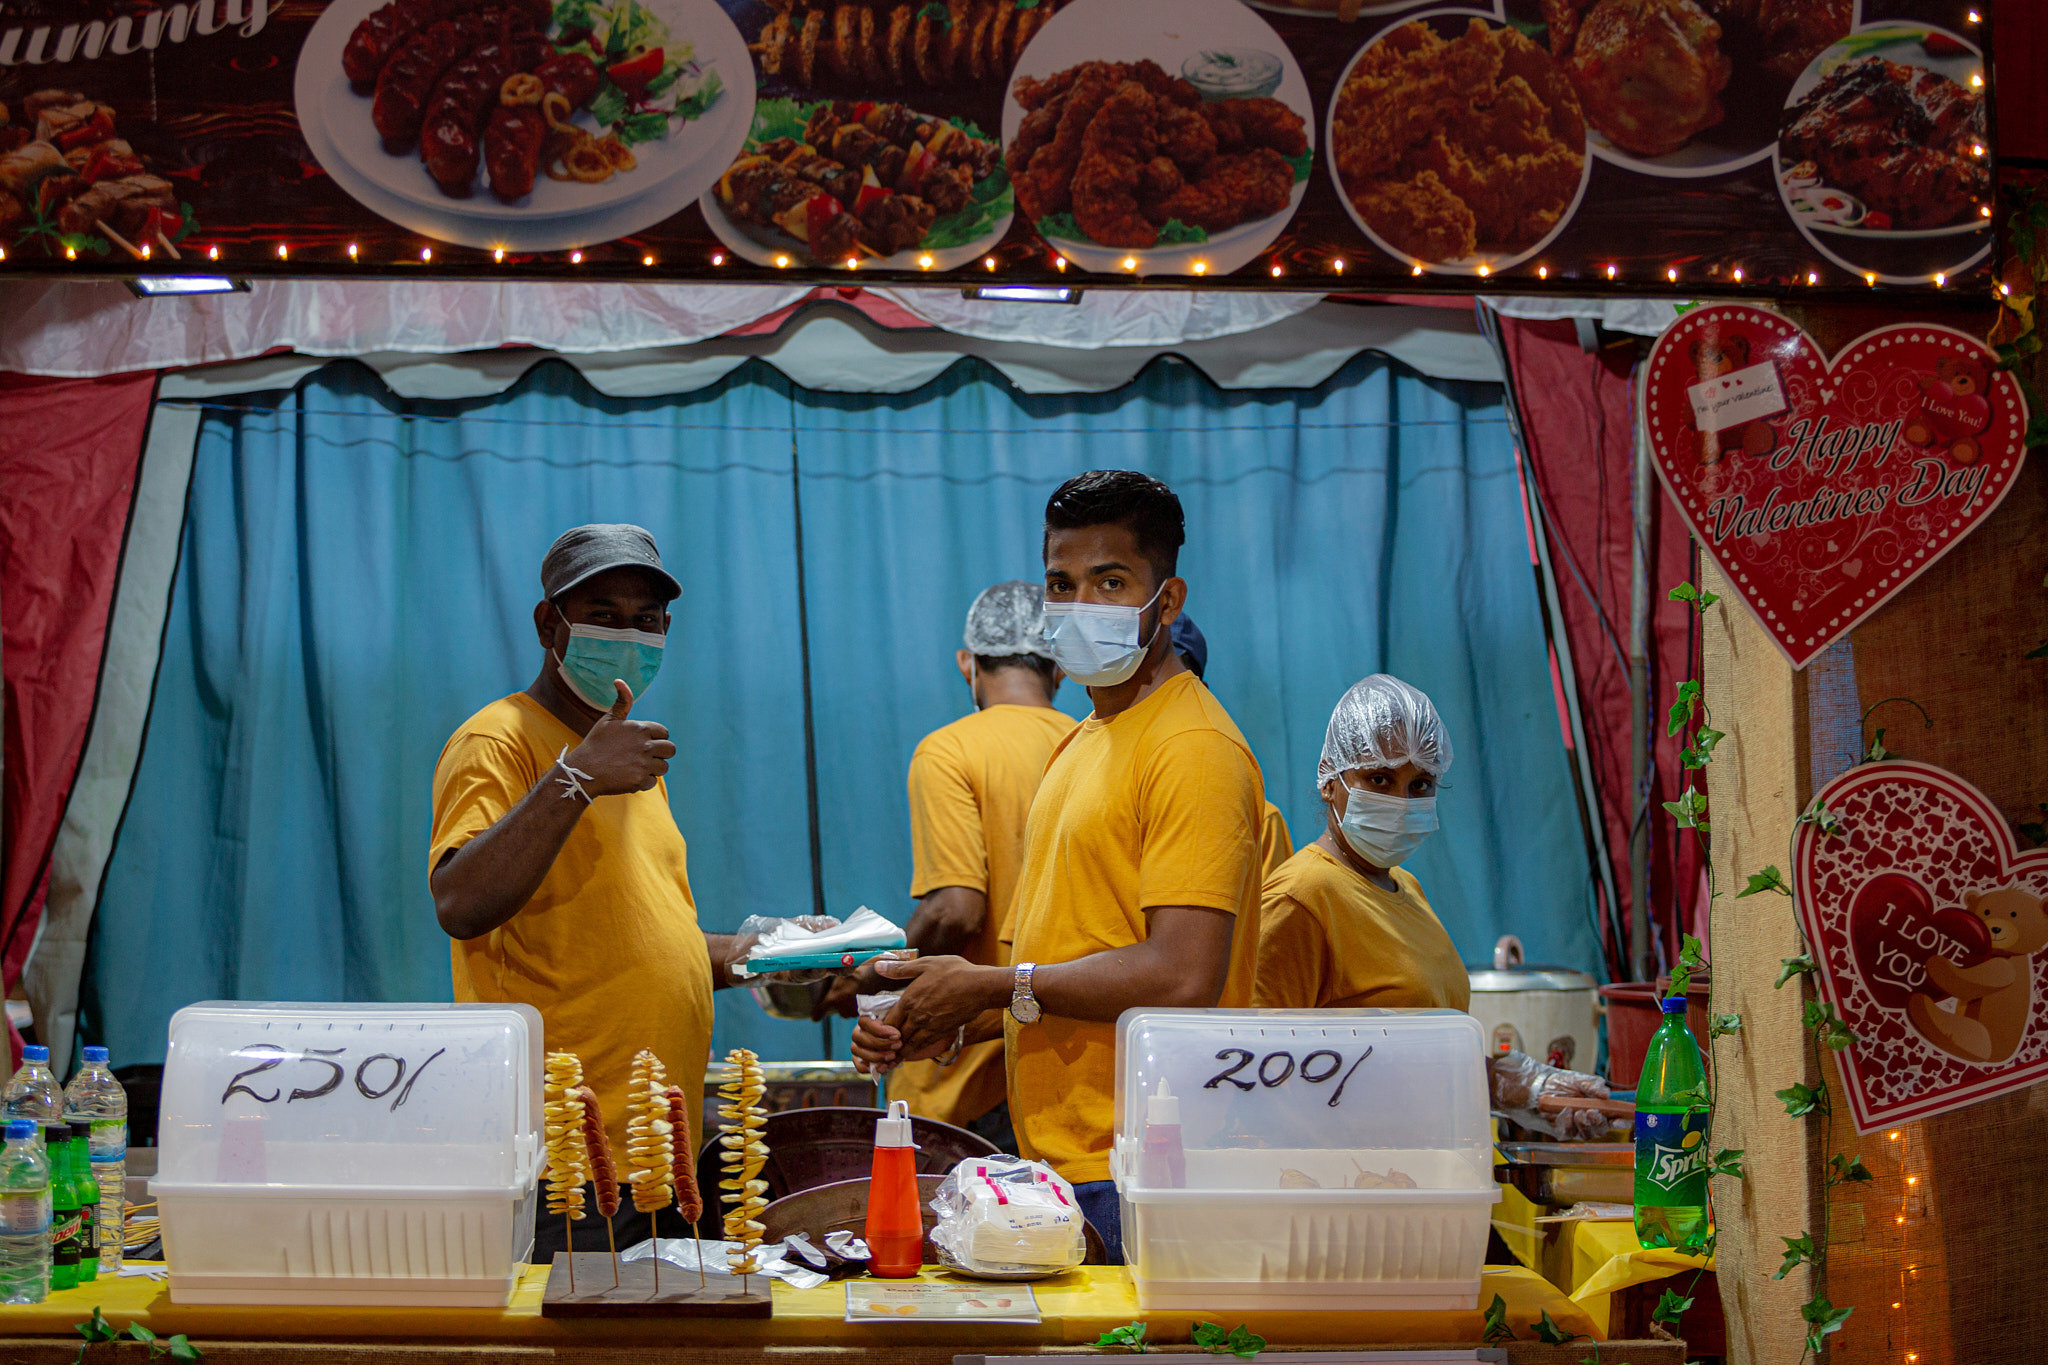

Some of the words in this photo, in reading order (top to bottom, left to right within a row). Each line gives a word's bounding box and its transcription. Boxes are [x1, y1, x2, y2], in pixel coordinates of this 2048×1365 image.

[0, 0, 285, 65] ummy
[1921, 396, 1928, 408] I
[1929, 399, 1955, 418] Love
[1958, 409, 1983, 428] You!
[1770, 415, 1902, 478] Happy
[1707, 485, 1890, 545] Valentines
[1896, 457, 1990, 512] Day
[1876, 941, 1927, 986] YOU
[1878, 902, 1896, 926] I
[1897, 914, 1970, 967] LOVE
